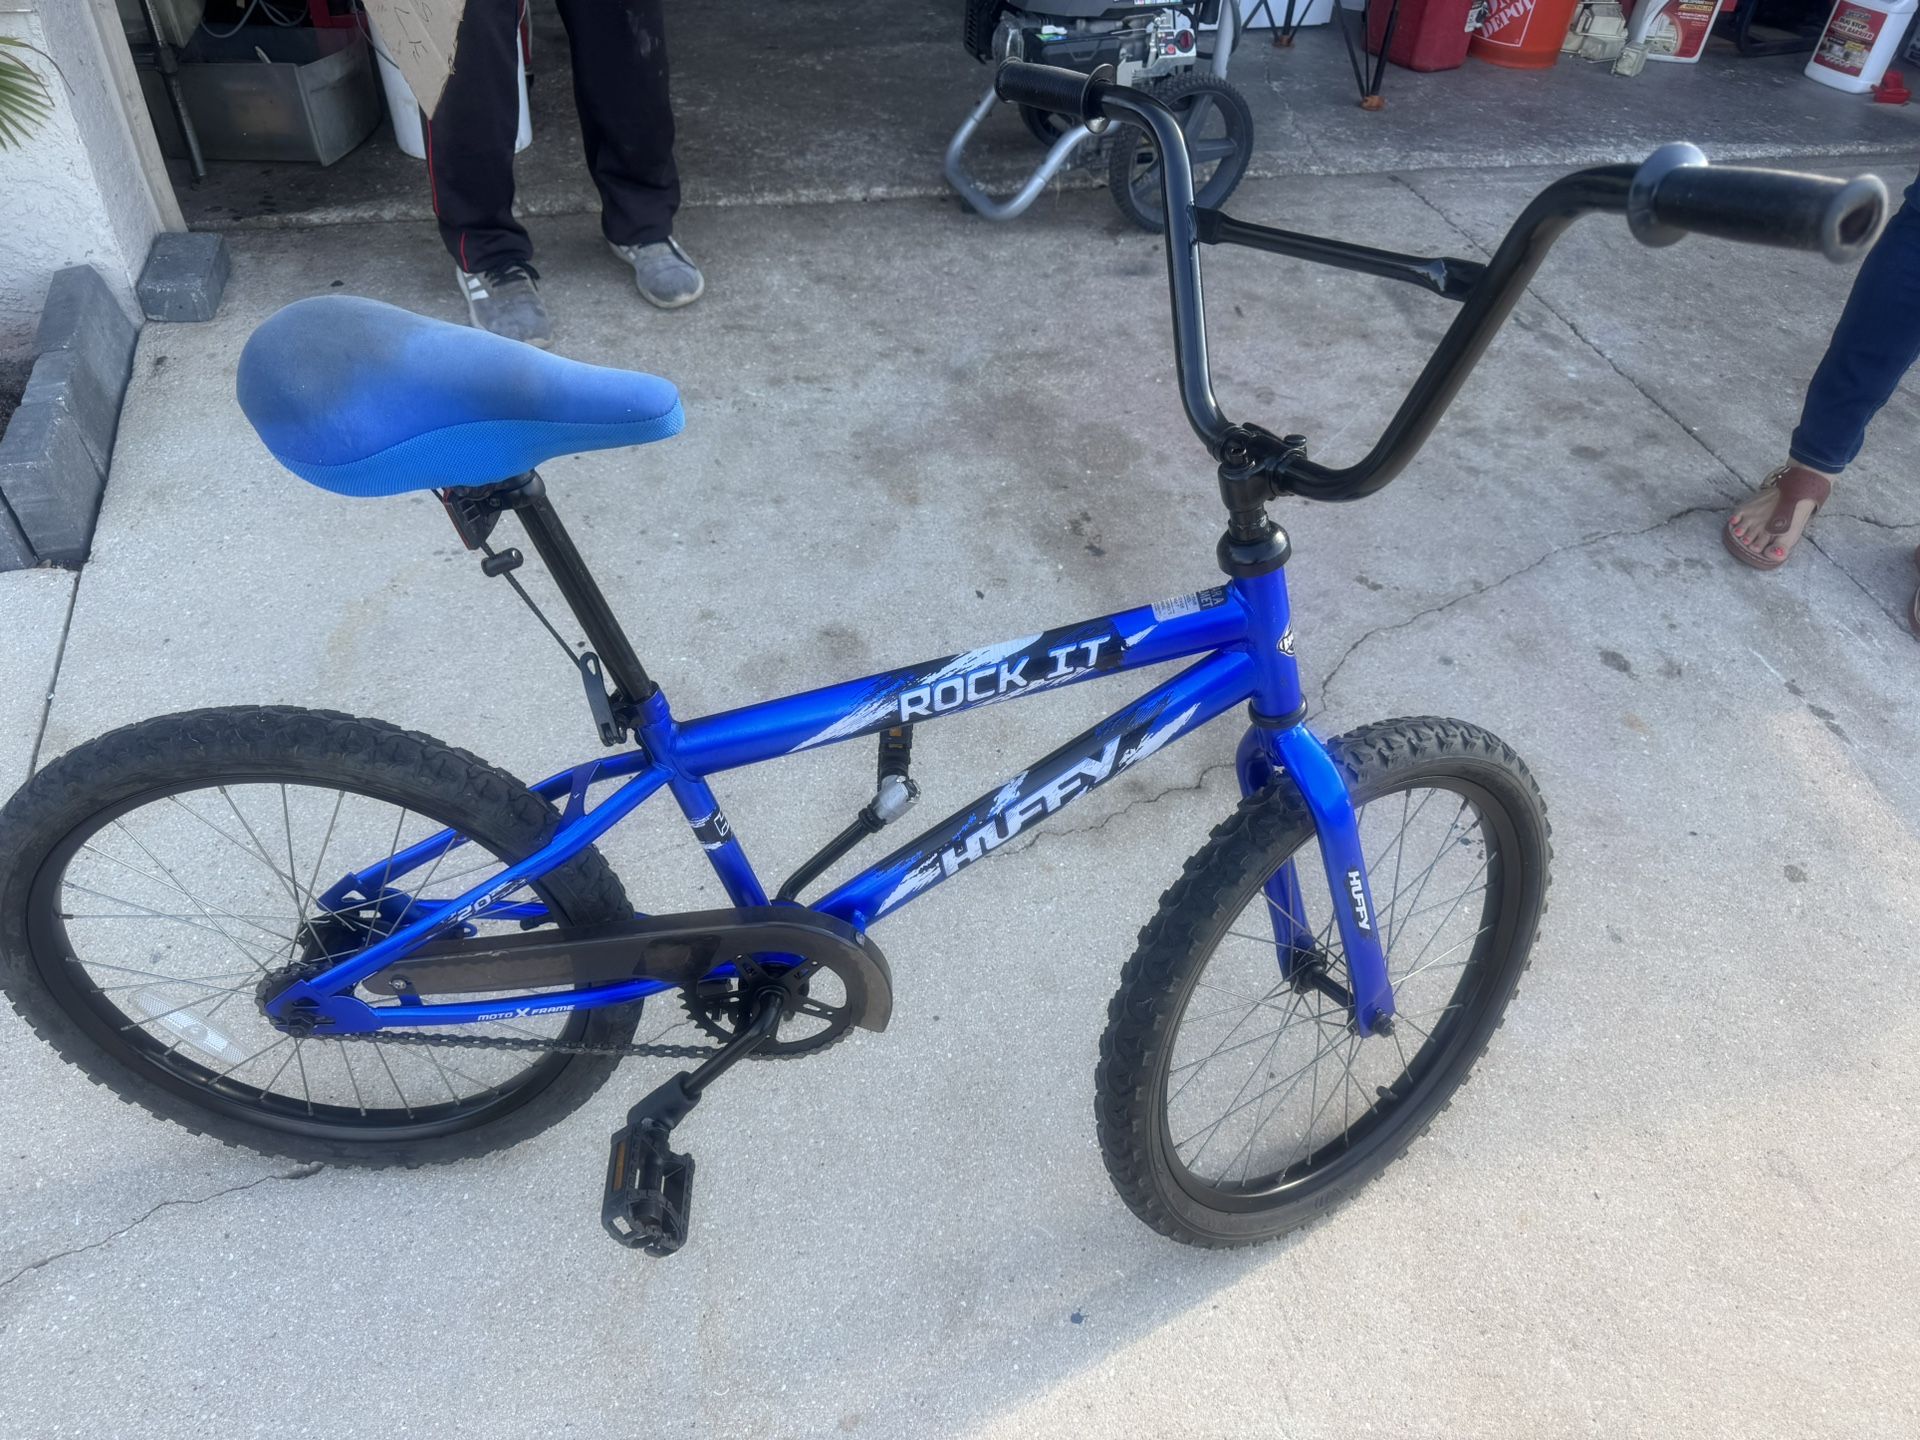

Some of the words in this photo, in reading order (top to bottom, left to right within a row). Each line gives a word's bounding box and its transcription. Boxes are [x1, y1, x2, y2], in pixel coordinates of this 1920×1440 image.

[899, 656, 1030, 723] ROCK
[1047, 633, 1111, 680] IT
[941, 734, 1123, 878] HUFFY
[1347, 870, 1371, 930] HUFFY
[477, 1012, 513, 1021] MOTO
[514, 1007, 531, 1018] X
[531, 1004, 575, 1016] FRAME
